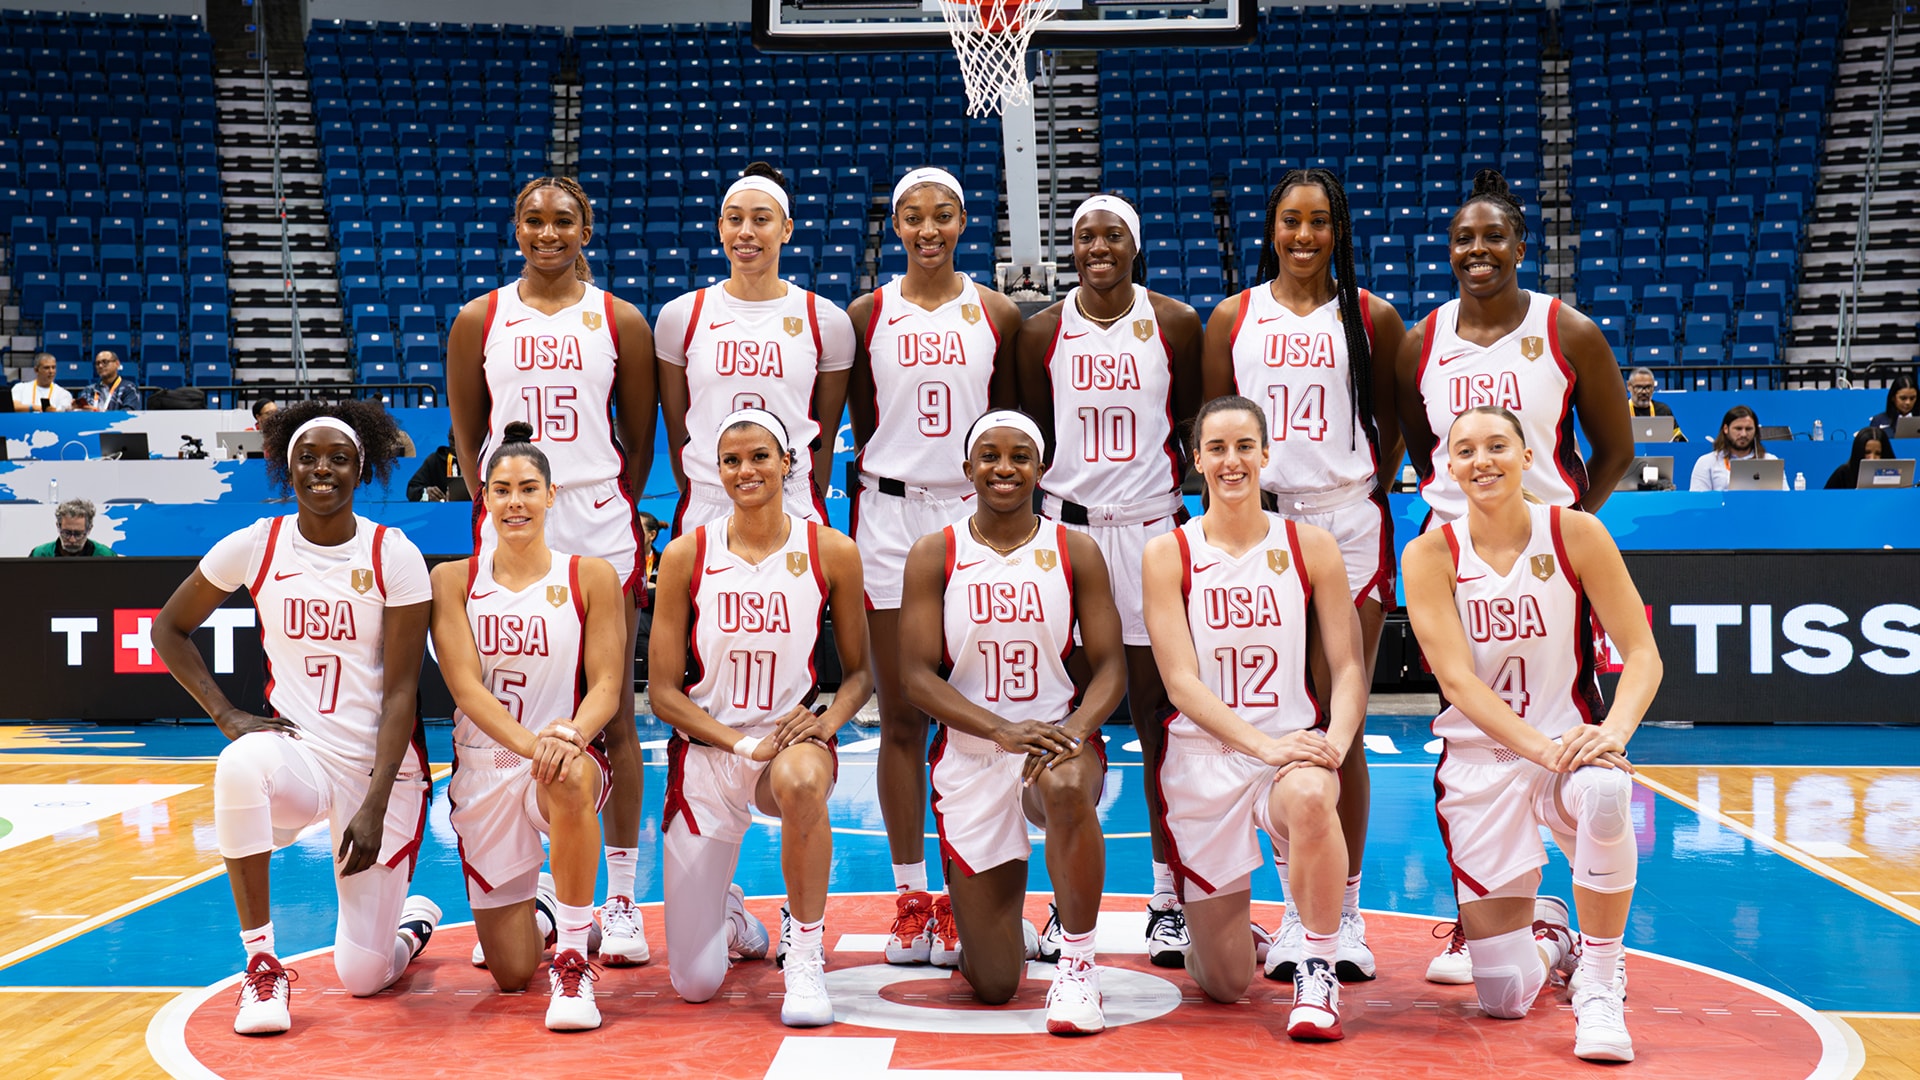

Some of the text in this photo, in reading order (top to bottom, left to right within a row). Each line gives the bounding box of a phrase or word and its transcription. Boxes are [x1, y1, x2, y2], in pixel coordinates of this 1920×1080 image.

[514, 335, 583, 371] USA
[715, 340, 784, 378] USA
[898, 331, 967, 367] USA
[1072, 354, 1140, 391] USA
[1264, 334, 1335, 368] USA
[522, 386, 578, 442] 15
[917, 381, 953, 438] 9
[1268, 384, 1328, 442] 14
[1450, 371, 1522, 411] USA
[1078, 406, 1137, 462] 10
[284, 598, 357, 641] USA
[718, 592, 792, 634] USA
[968, 582, 1045, 624] USA
[1204, 586, 1282, 630] USA
[1467, 594, 1547, 643] USA
[478, 614, 549, 657] USA
[1670, 604, 1920, 675] TISS
[304, 654, 342, 714] 7
[729, 650, 778, 711] 11
[977, 640, 1038, 702] 13
[1214, 645, 1279, 708] 12
[1494, 656, 1531, 718] 4
[492, 668, 527, 726] 5
